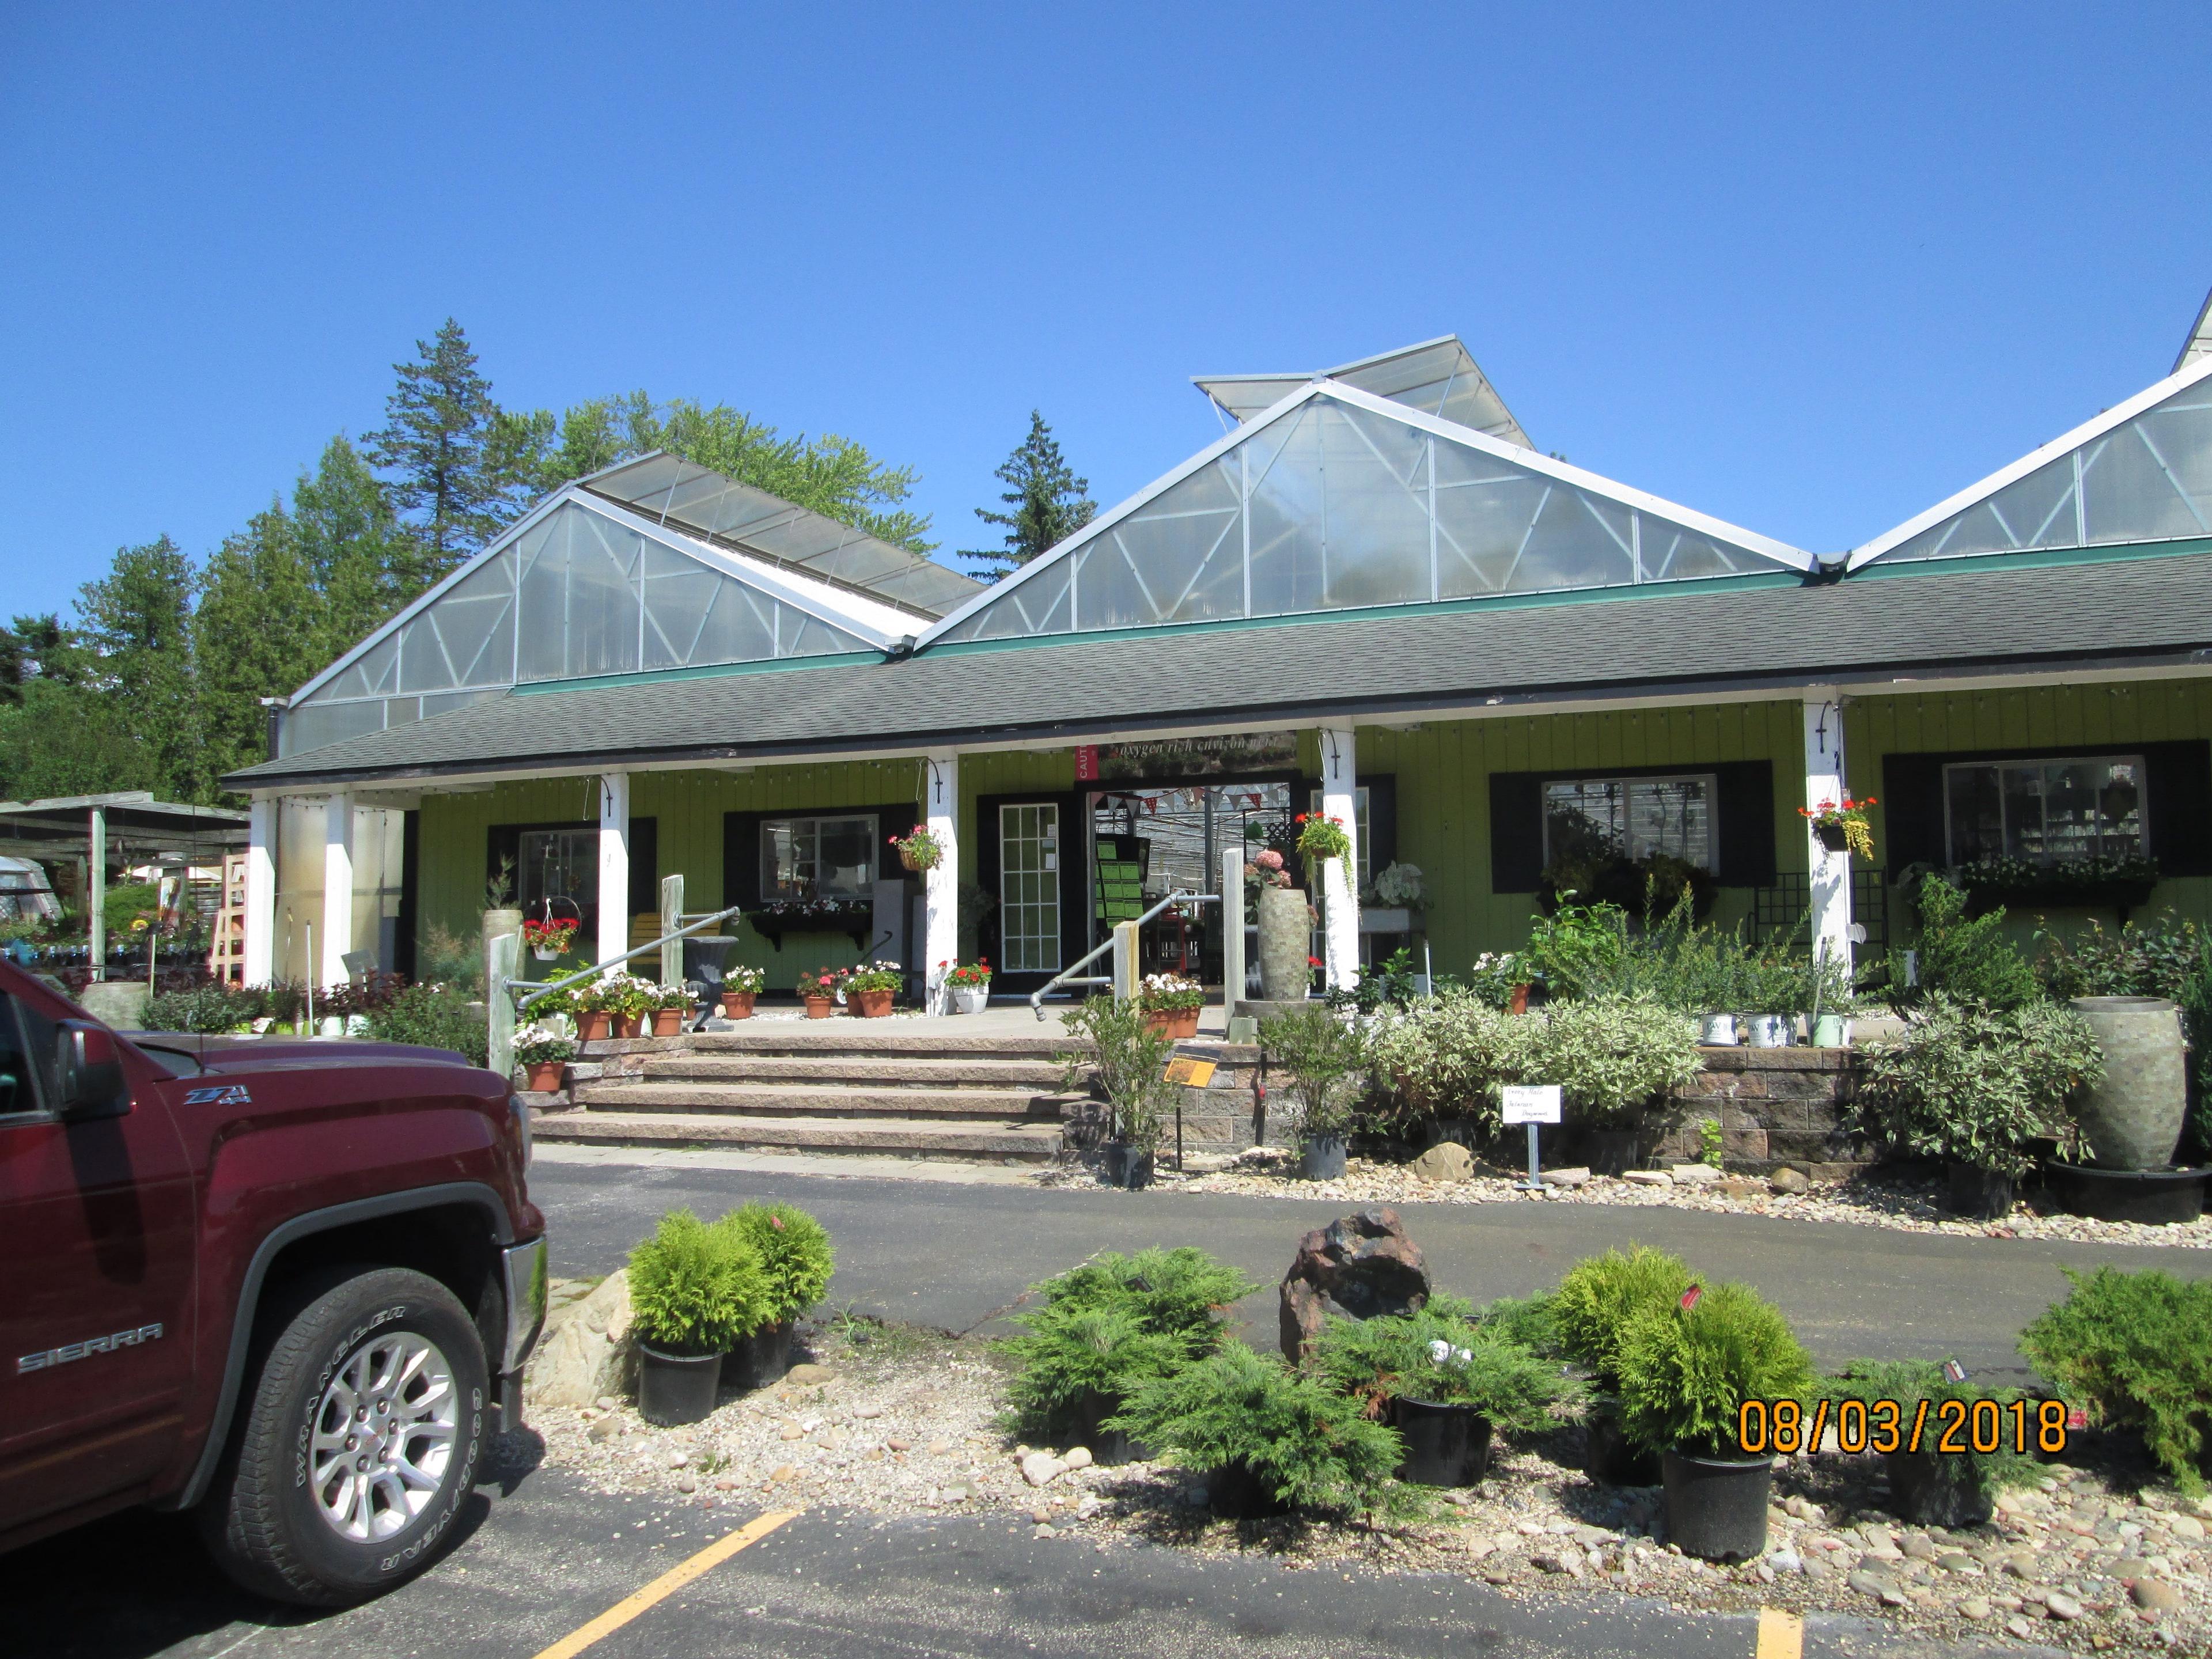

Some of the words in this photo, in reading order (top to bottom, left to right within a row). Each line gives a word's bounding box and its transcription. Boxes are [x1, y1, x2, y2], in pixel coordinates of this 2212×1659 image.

[1120, 743, 1162, 758] oxygen
[1508, 1088, 1525, 1099] Ivory
[17, 1323, 164, 1375] SIERRA
[296, 1306, 407, 1487] WRANGLER
[381, 1387, 483, 1571] GOODYEAR
